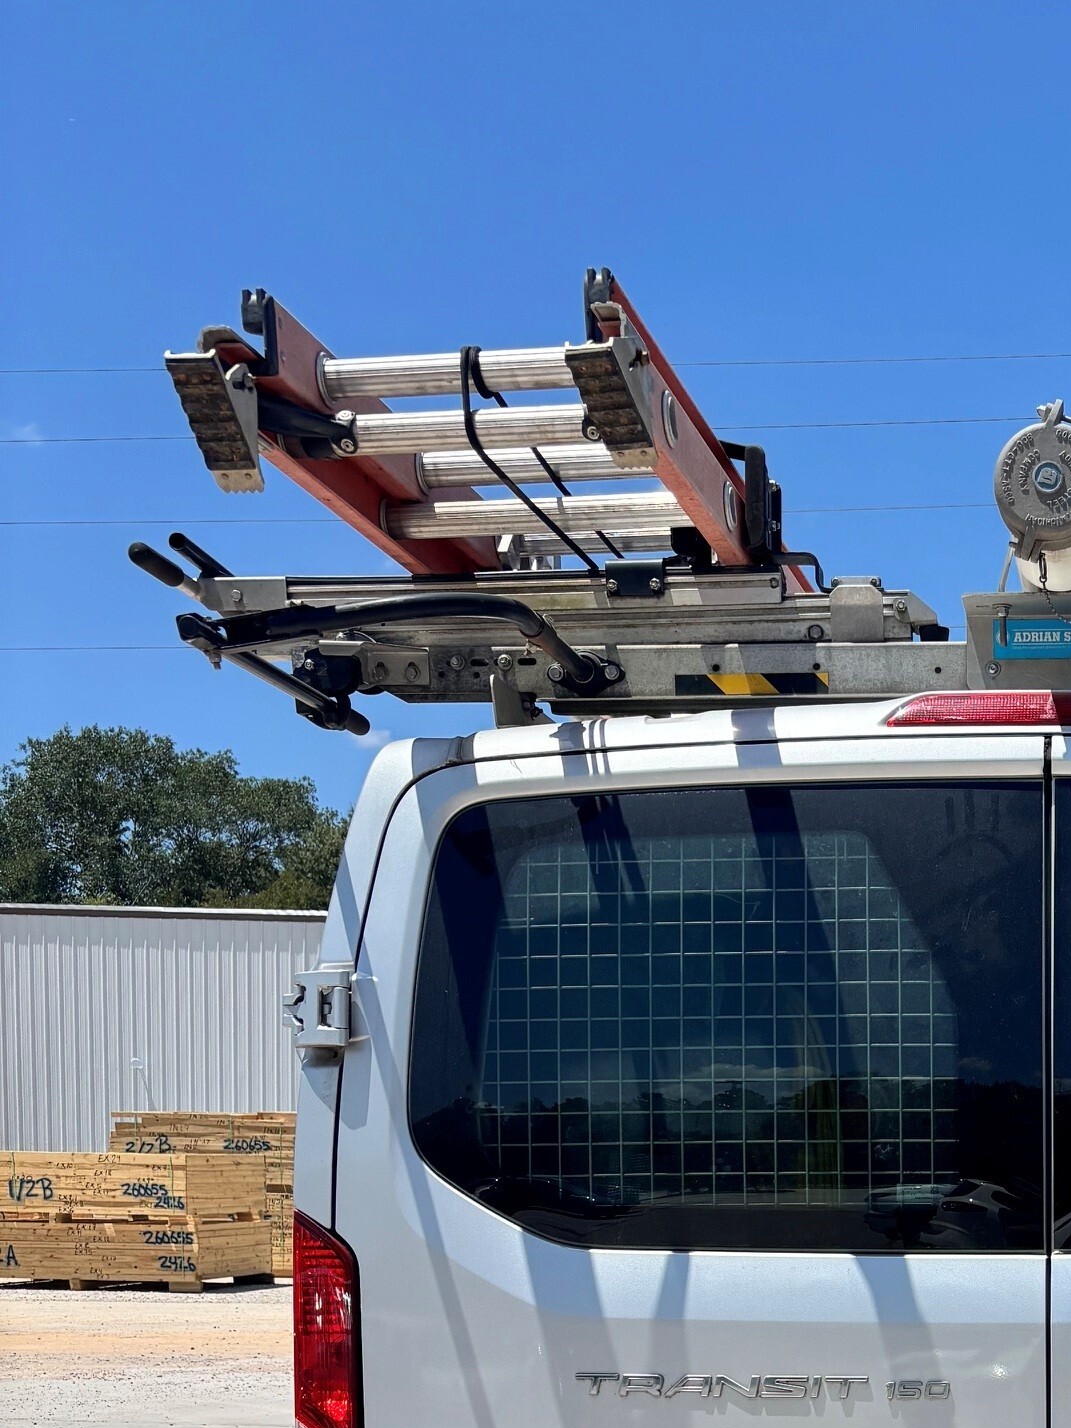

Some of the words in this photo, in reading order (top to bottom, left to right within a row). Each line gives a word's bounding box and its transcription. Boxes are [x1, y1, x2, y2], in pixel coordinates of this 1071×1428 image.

[1014, 631, 1060, 643] ADRIAN
[121, 1183, 169, 1197] 260655
[575, 1372, 869, 1399] TRANSIT
[884, 1380, 951, 1401] 150
